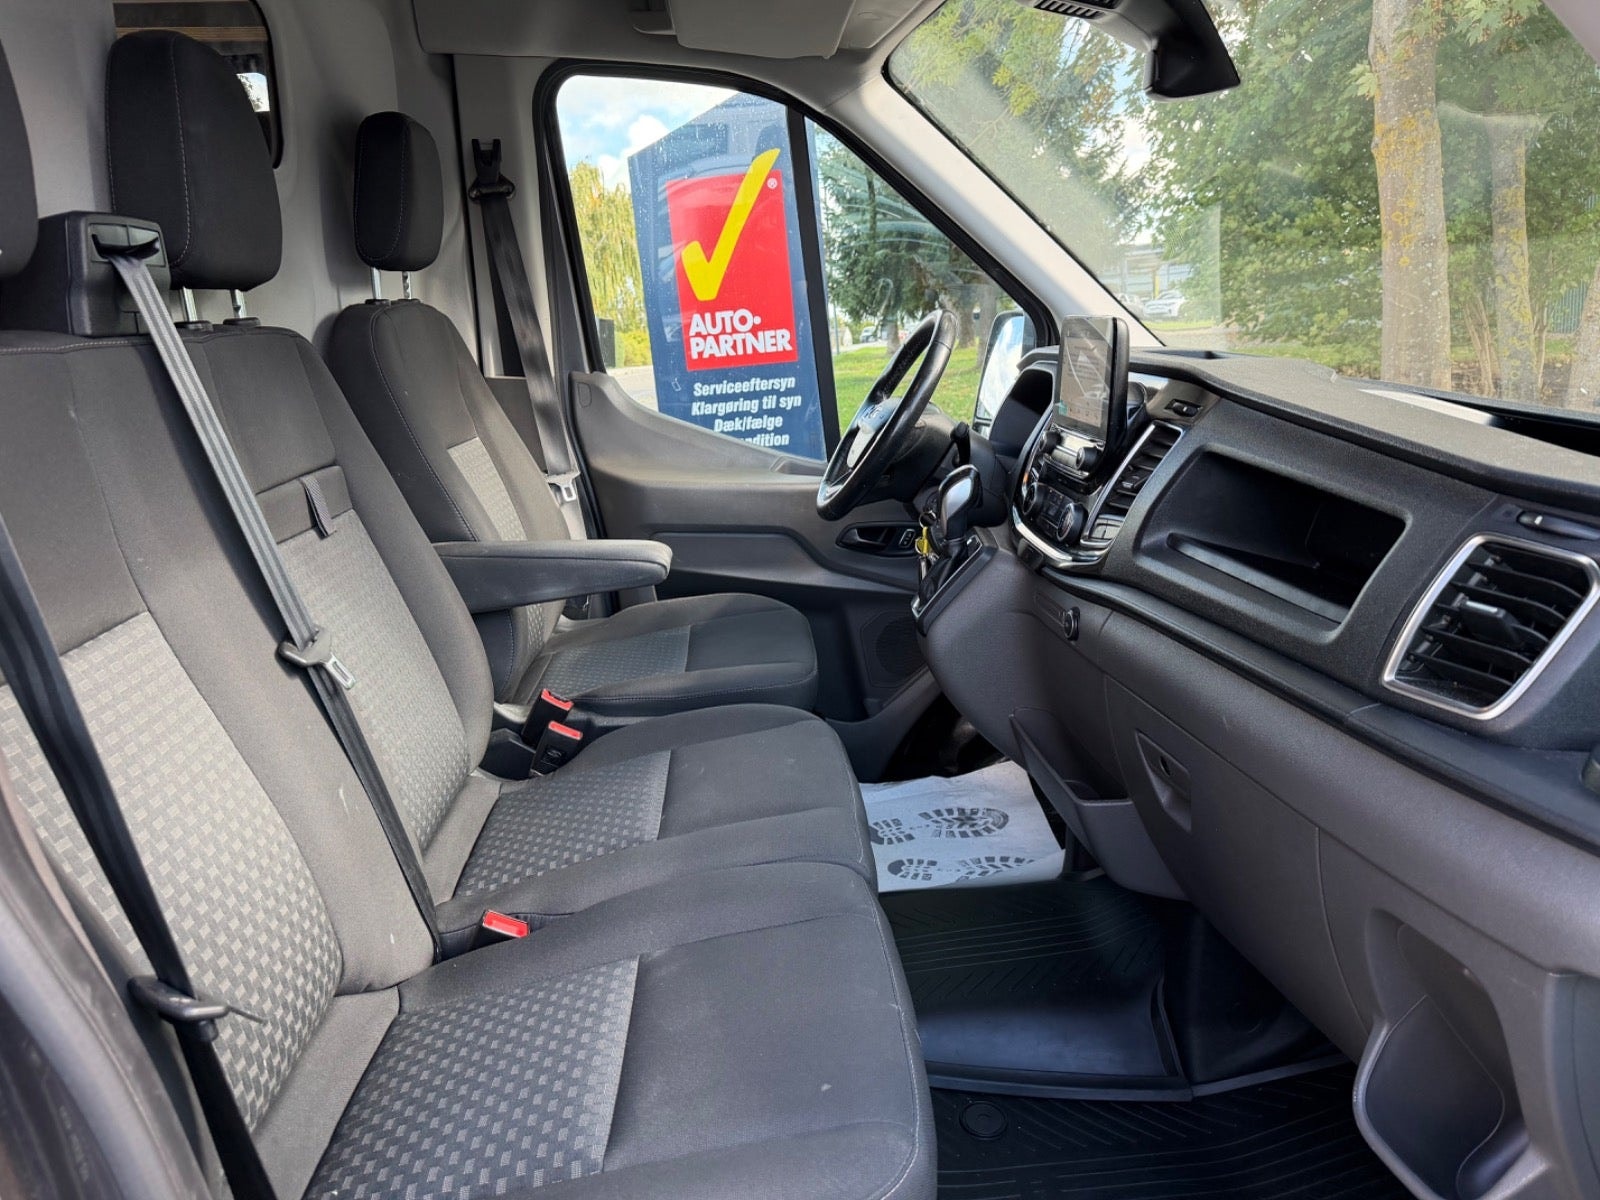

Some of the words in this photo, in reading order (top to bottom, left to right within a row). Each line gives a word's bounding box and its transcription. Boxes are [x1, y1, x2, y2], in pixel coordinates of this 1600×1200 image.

[690, 328, 793, 360] PARTNER
[693, 376, 796, 397] Serviceeftersyn
[691, 398, 759, 416] Klargøring
[762, 394, 777, 410] til
[779, 395, 802, 410] syn
[714, 414, 783, 432] Dæk/fælge
